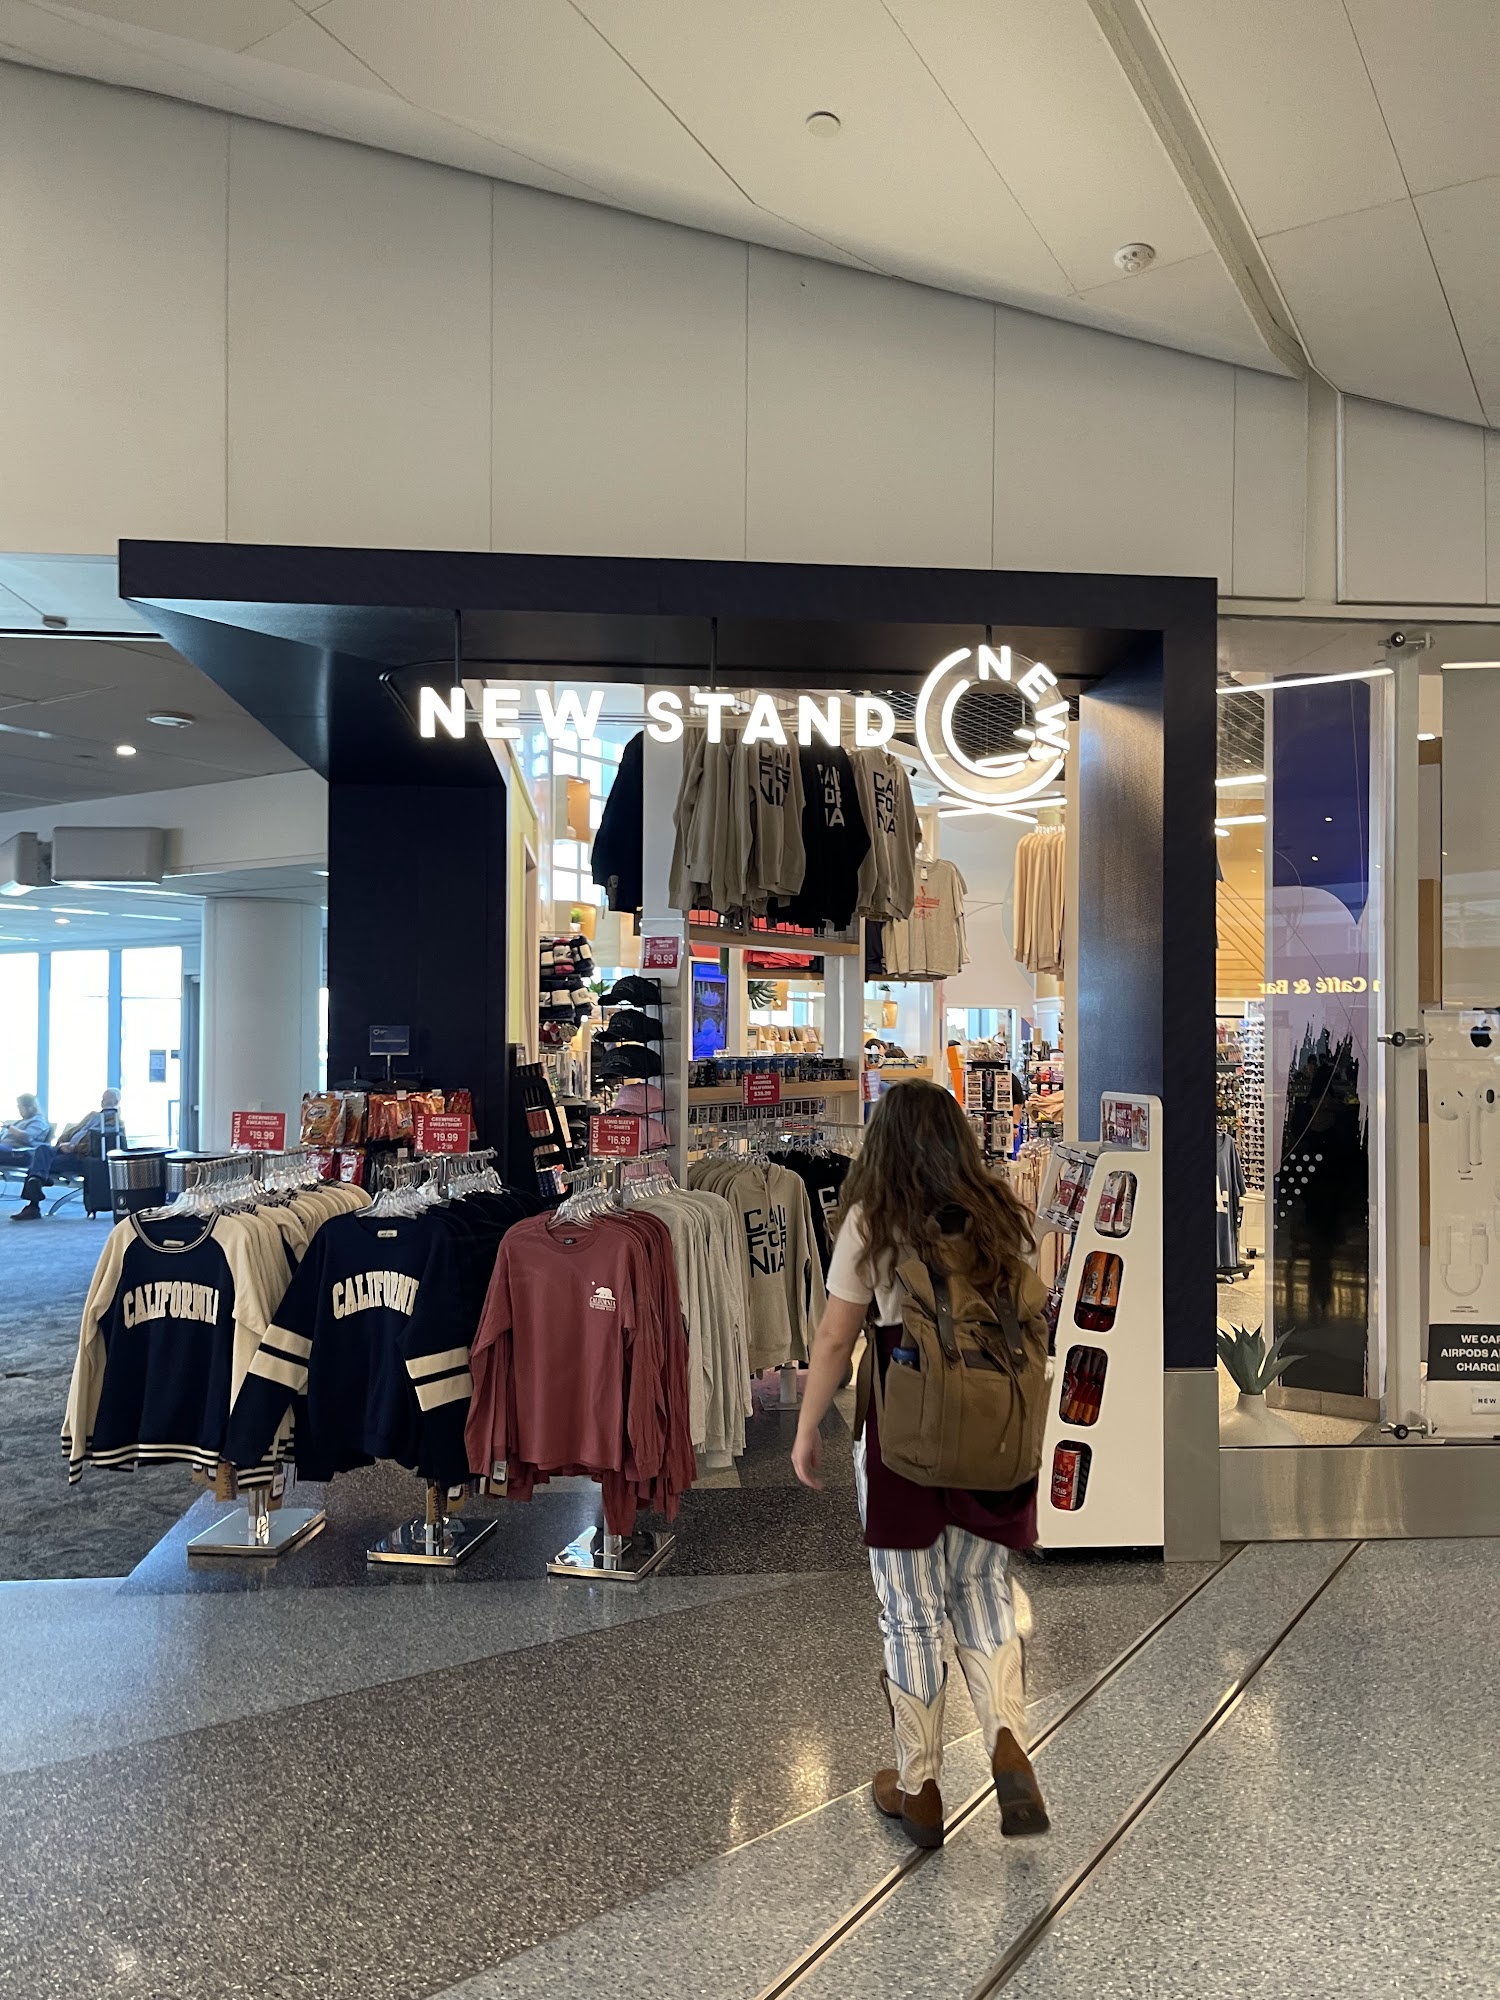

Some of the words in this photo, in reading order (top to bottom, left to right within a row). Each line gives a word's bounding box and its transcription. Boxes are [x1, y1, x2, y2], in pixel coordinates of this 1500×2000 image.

[978, 644, 1070, 753] NEW
[420, 686, 605, 740] NEW
[646, 690, 896, 747] STAND
[653, 954, 674, 965] $9.99
[232, 1113, 241, 1147] PECIAL!
[249, 1130, 275, 1141] $19.99
[416, 1115, 424, 1150] SPECIAL!
[433, 1132, 459, 1142] $19.99
[592, 1117, 600, 1153] SPECIAL!
[607, 1135, 631, 1145] $16.99
[123, 1280, 219, 1329] CALIFORNI
[332, 1270, 420, 1320] CALIFORNI
[1440, 1348, 1489, 1358] AIRPODS
[1461, 1334, 1479, 1344] WE
